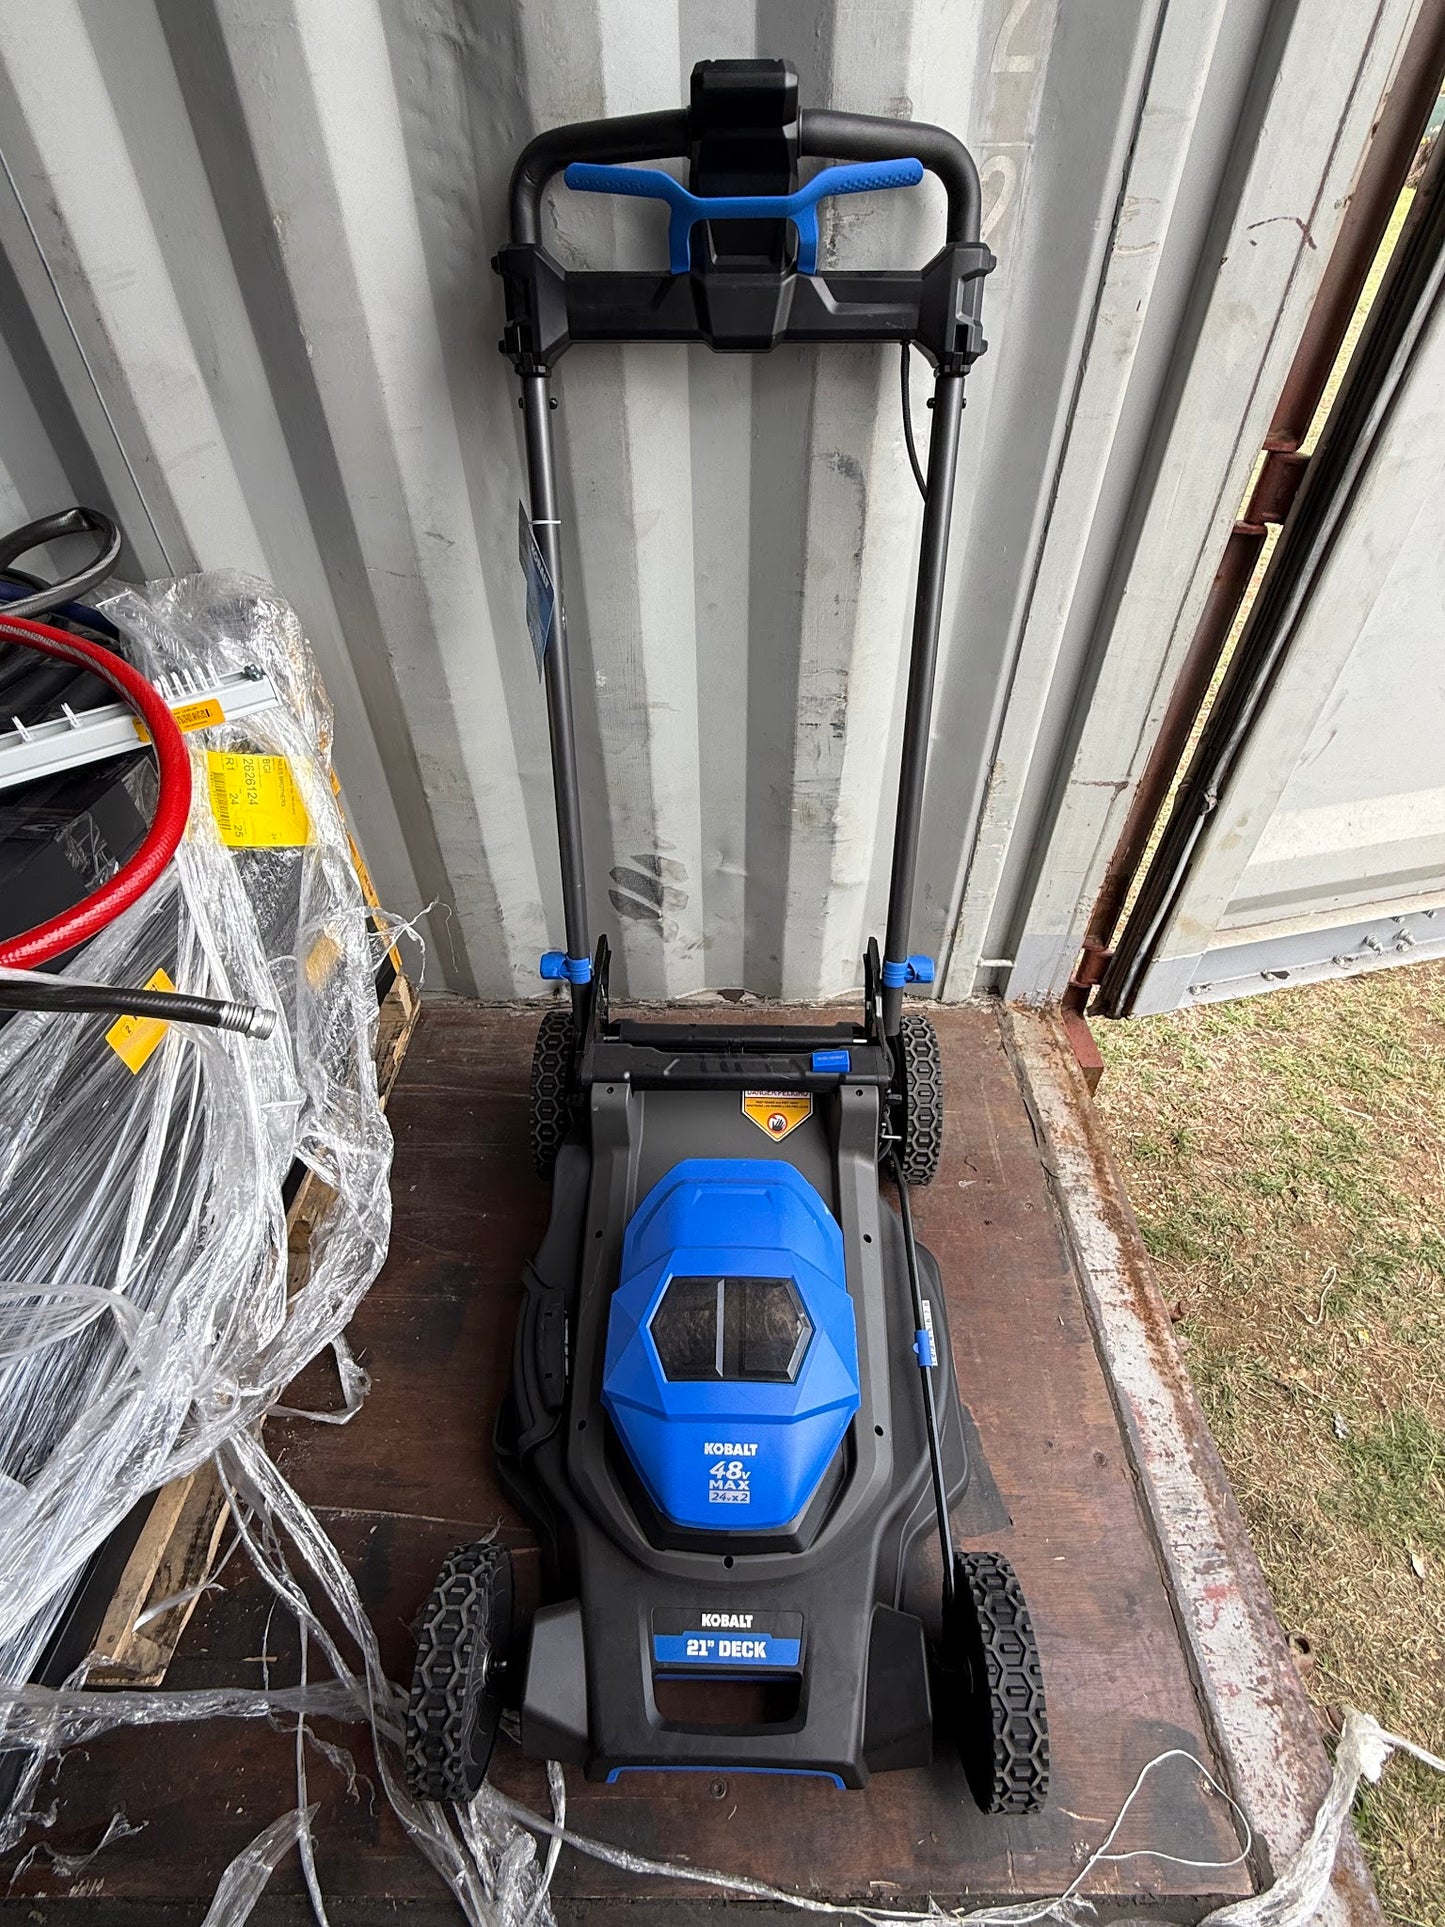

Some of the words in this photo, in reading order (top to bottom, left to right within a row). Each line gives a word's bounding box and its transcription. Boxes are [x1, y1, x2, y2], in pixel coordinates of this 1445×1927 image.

[225, 757, 235, 771] R1
[243, 758, 258, 806] 2626124
[229, 793, 240, 805] 24
[234, 825, 244, 838] 25
[704, 1442, 758, 1456] KOBALT
[709, 1479, 750, 1490] MAX
[702, 1613, 754, 1628] KOBALT
[718, 1640, 767, 1659] DECK
